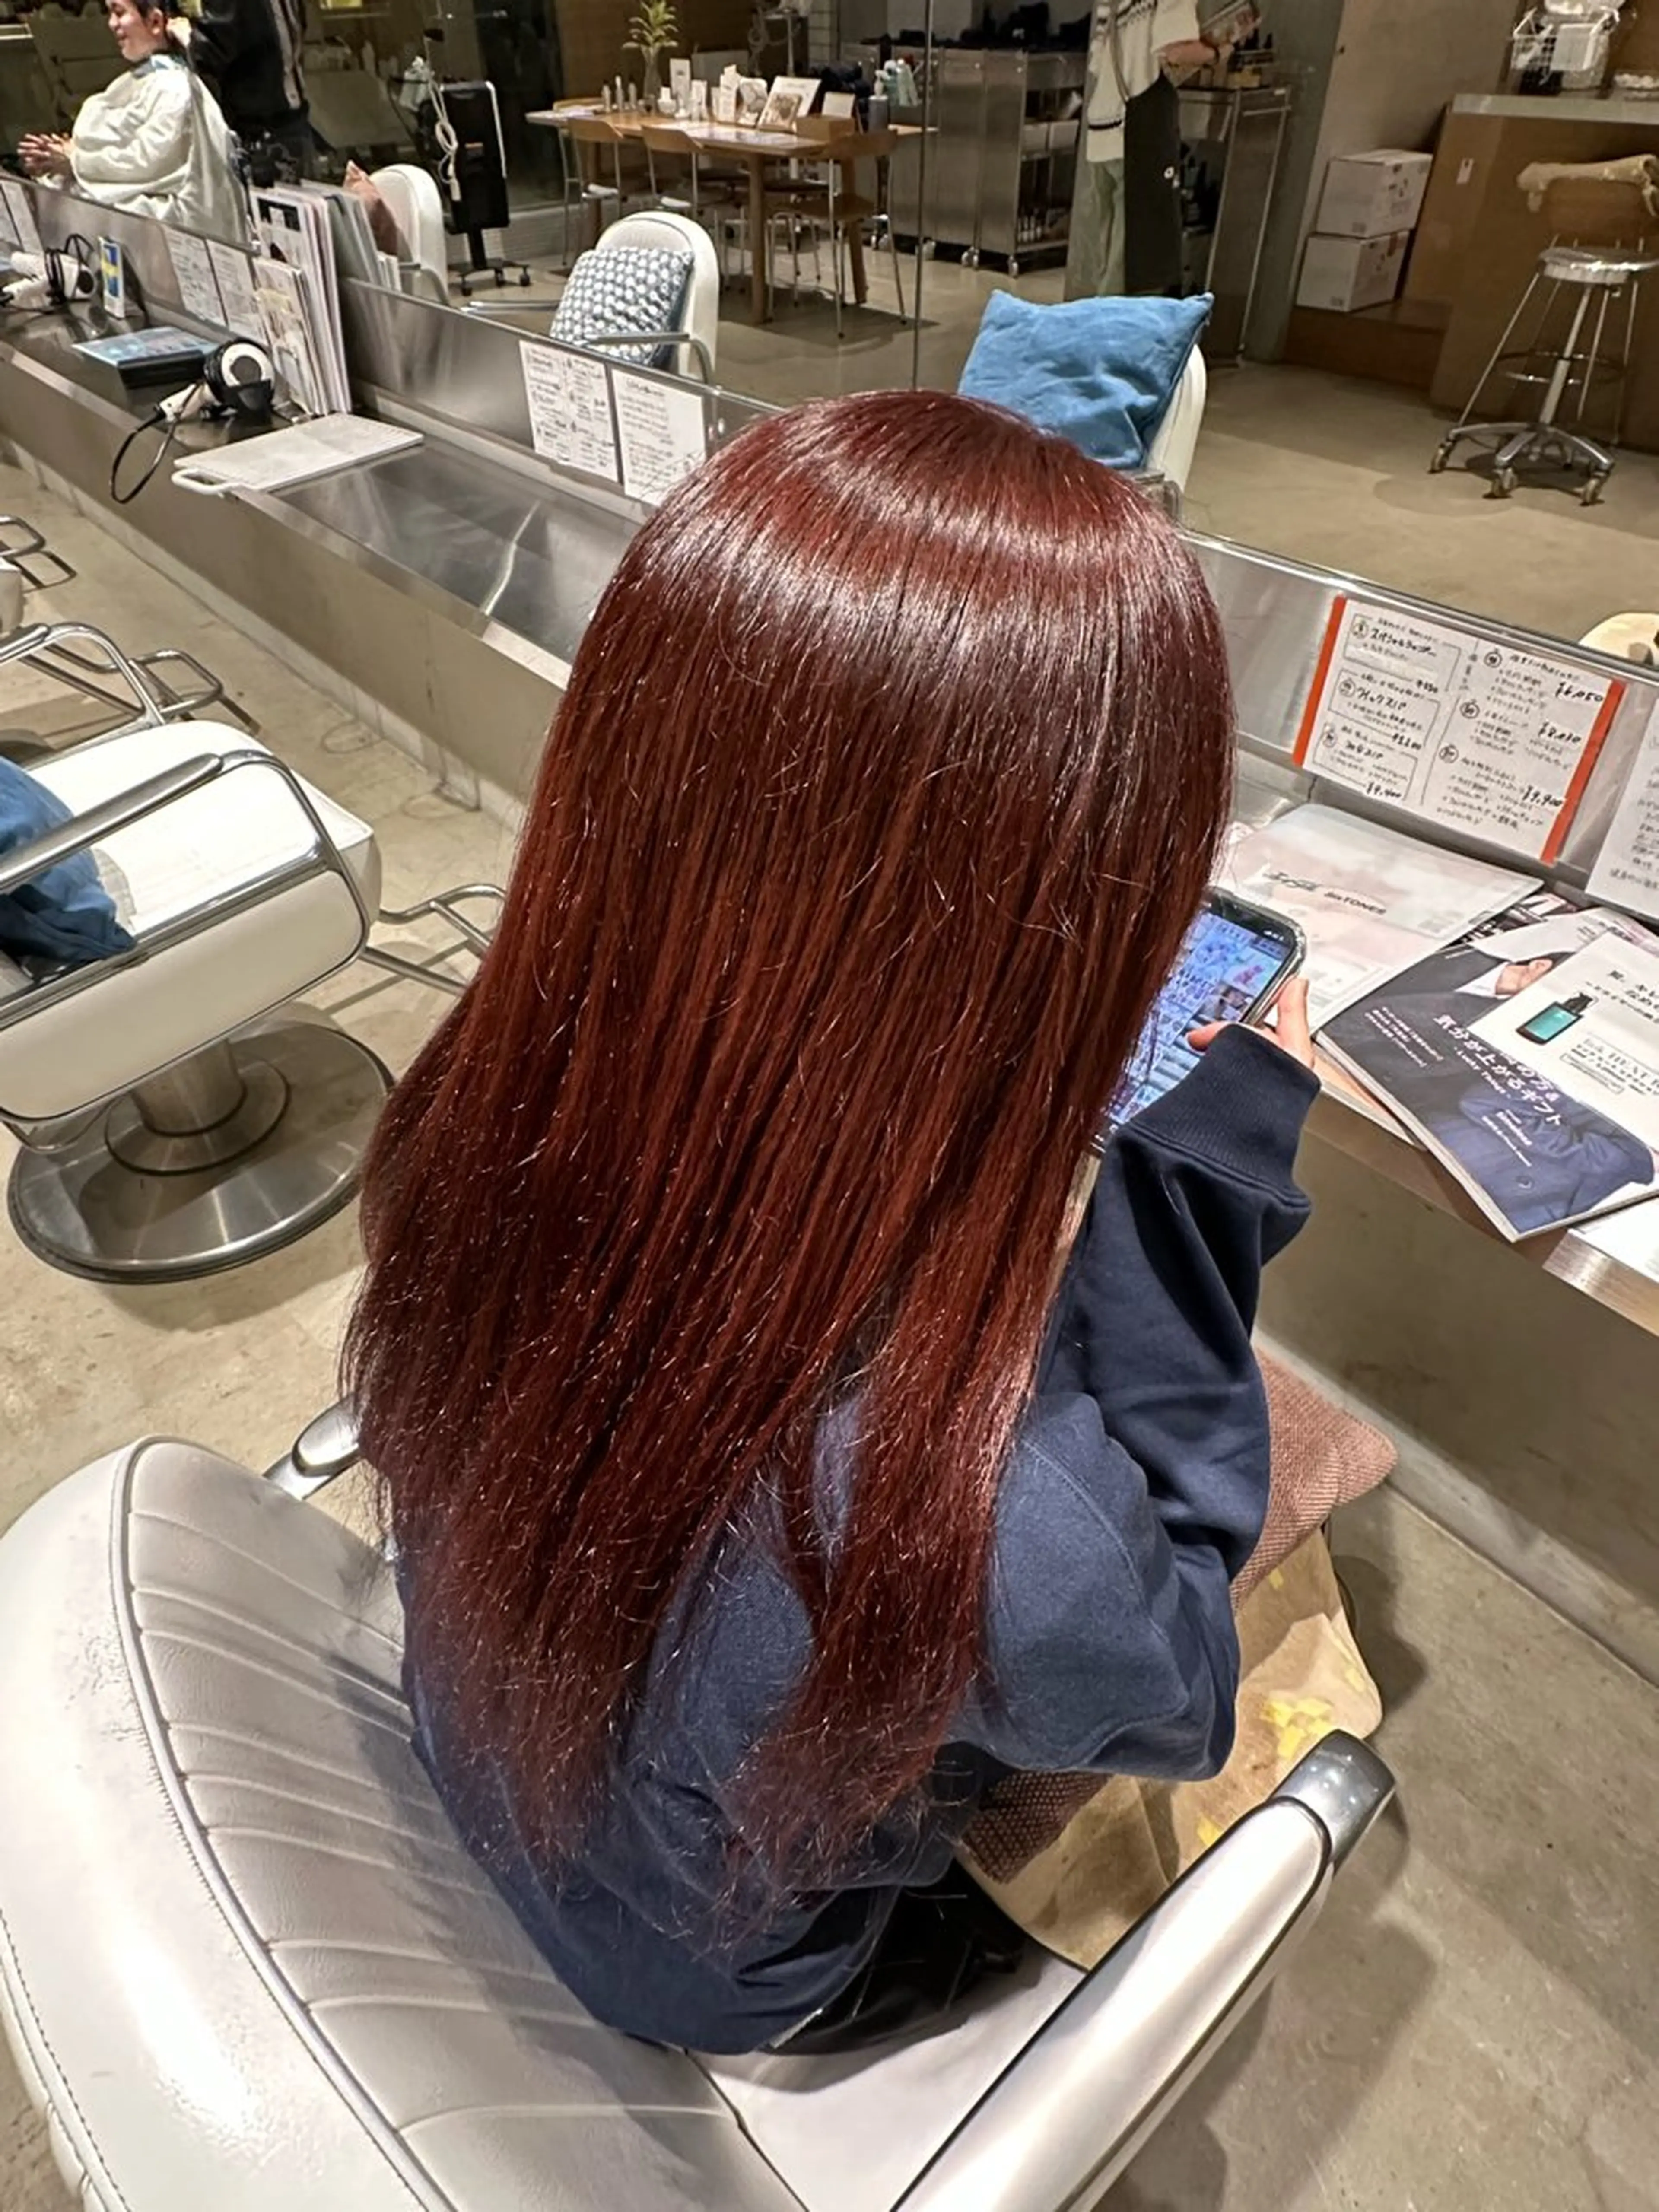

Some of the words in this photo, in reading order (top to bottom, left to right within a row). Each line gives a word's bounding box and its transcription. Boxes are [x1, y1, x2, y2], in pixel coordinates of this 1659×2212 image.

[1433, 1015, 1561, 1125] 気分が上がるギフト
